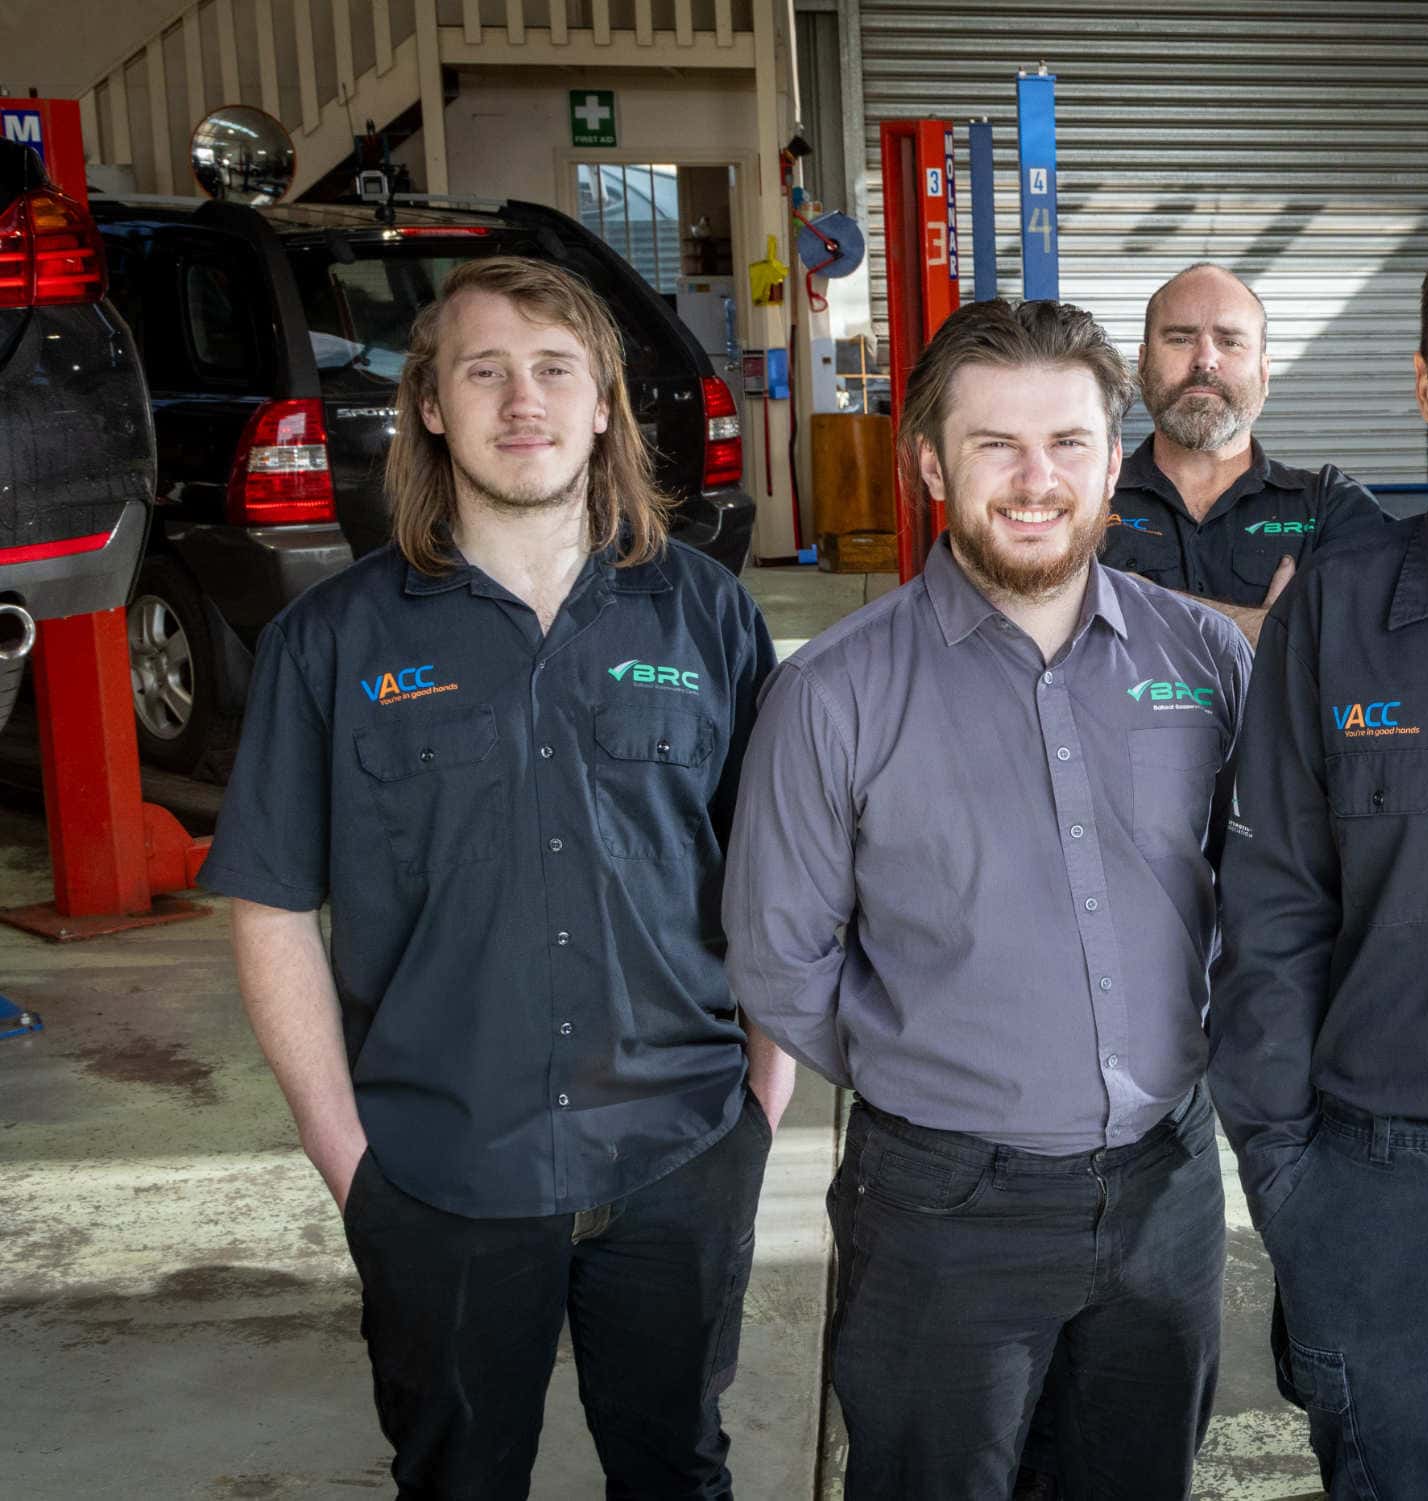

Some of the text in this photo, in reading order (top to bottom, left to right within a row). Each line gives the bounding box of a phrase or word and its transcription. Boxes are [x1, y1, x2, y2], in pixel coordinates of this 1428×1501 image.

[930, 171, 940, 194] 3
[1033, 172, 1044, 191] 4
[944, 134, 957, 278] MOLNAR
[927, 222, 947, 266] 3
[1028, 208, 1051, 253] 4
[361, 665, 434, 701] VACC
[411, 688, 433, 699] good
[433, 682, 459, 694] hands
[633, 664, 699, 691] BRC
[1150, 682, 1214, 706] BRC
[1332, 701, 1402, 730] VACC
[1345, 729, 1366, 738] You're
[1374, 726, 1395, 737] good
[1395, 725, 1421, 735] hands
